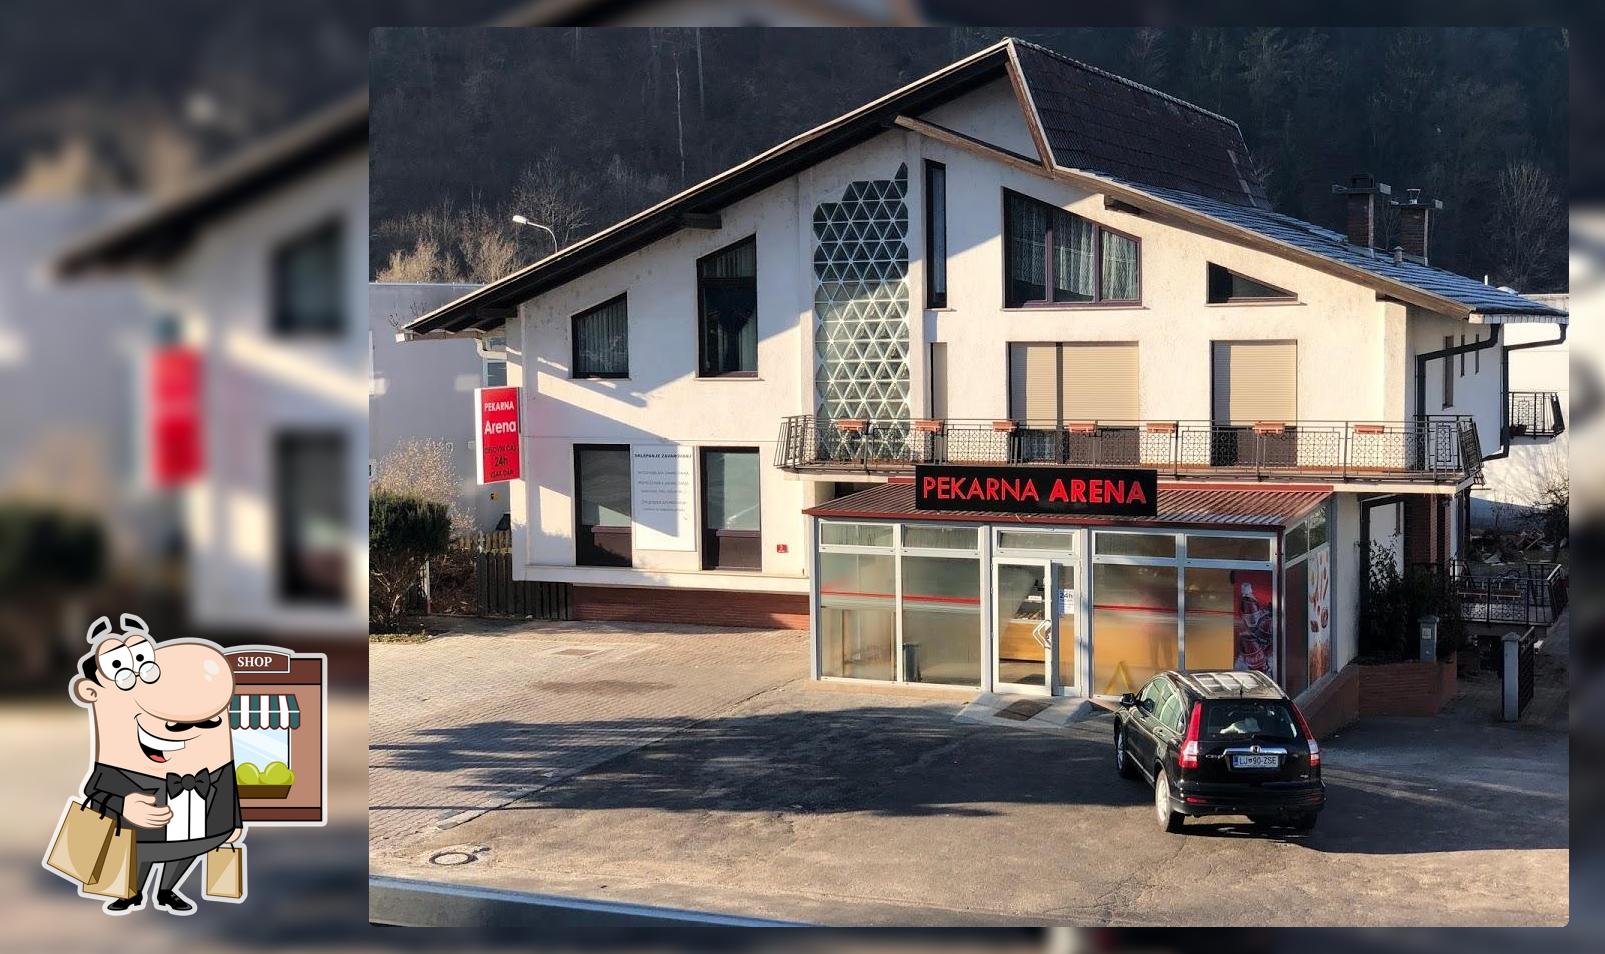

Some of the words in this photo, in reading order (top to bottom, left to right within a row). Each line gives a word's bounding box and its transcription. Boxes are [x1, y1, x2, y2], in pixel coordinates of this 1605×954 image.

[484, 401, 515, 412] PEKARNA
[484, 420, 517, 435] Arena
[495, 455, 508, 467] 24h
[922, 476, 1040, 501] PEKARNA
[1048, 478, 1148, 504] ARENA
